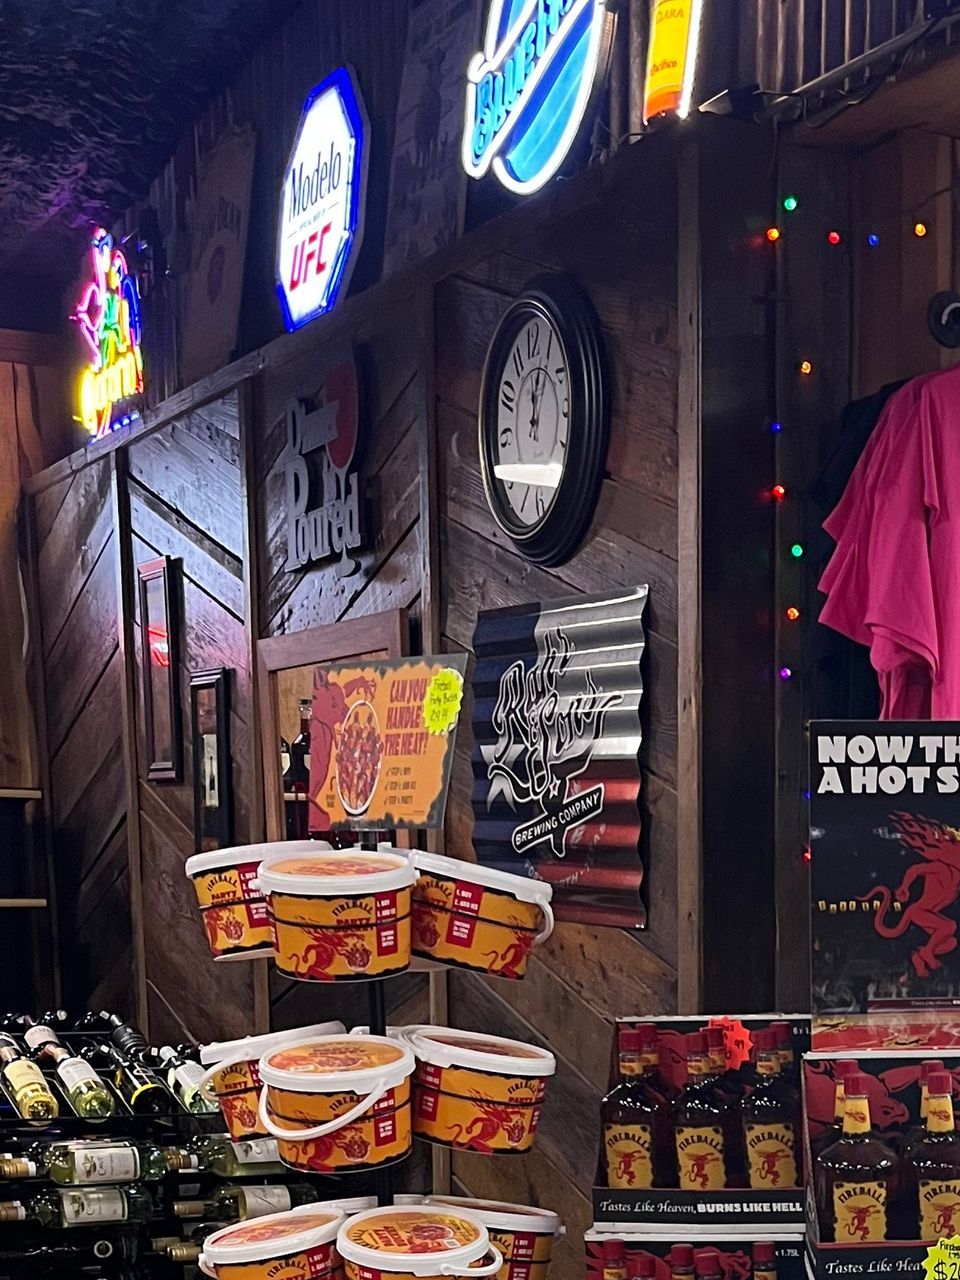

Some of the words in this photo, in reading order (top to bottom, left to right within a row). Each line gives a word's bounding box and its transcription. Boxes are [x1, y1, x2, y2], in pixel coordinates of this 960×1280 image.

[288, 140, 342, 224] Modelo
[289, 221, 333, 292] UFC
[390, 680, 407, 703] CAN
[386, 706, 422, 729] HANDLE
[384, 734, 401, 756] THE
[817, 735, 914, 764] NOW
[817, 767, 844, 794] A
[850, 766, 931, 794] HOT
[515, 817, 559, 847] BREWING
[558, 792, 600, 824] COMPANY
[332, 900, 373, 916] FIREBALL
[606, 1132, 650, 1150] FIREBALL
[678, 1135, 723, 1152] FIREBALL
[749, 1132, 795, 1150] FIREBALL
[600, 1200, 632, 1213] Tastes
[633, 1201, 654, 1213] Like
[657, 1200, 697, 1214] Heaven,
[697, 1203, 742, 1213] BURNS
[742, 1203, 771, 1213] LIKE
[772, 1202, 803, 1212] HELL
[837, 1188, 887, 1206] FIREBALL
[266, 1259, 308, 1278] FIREBALL
[826, 1260, 864, 1274] Tastes
[866, 1259, 893, 1273] Like
